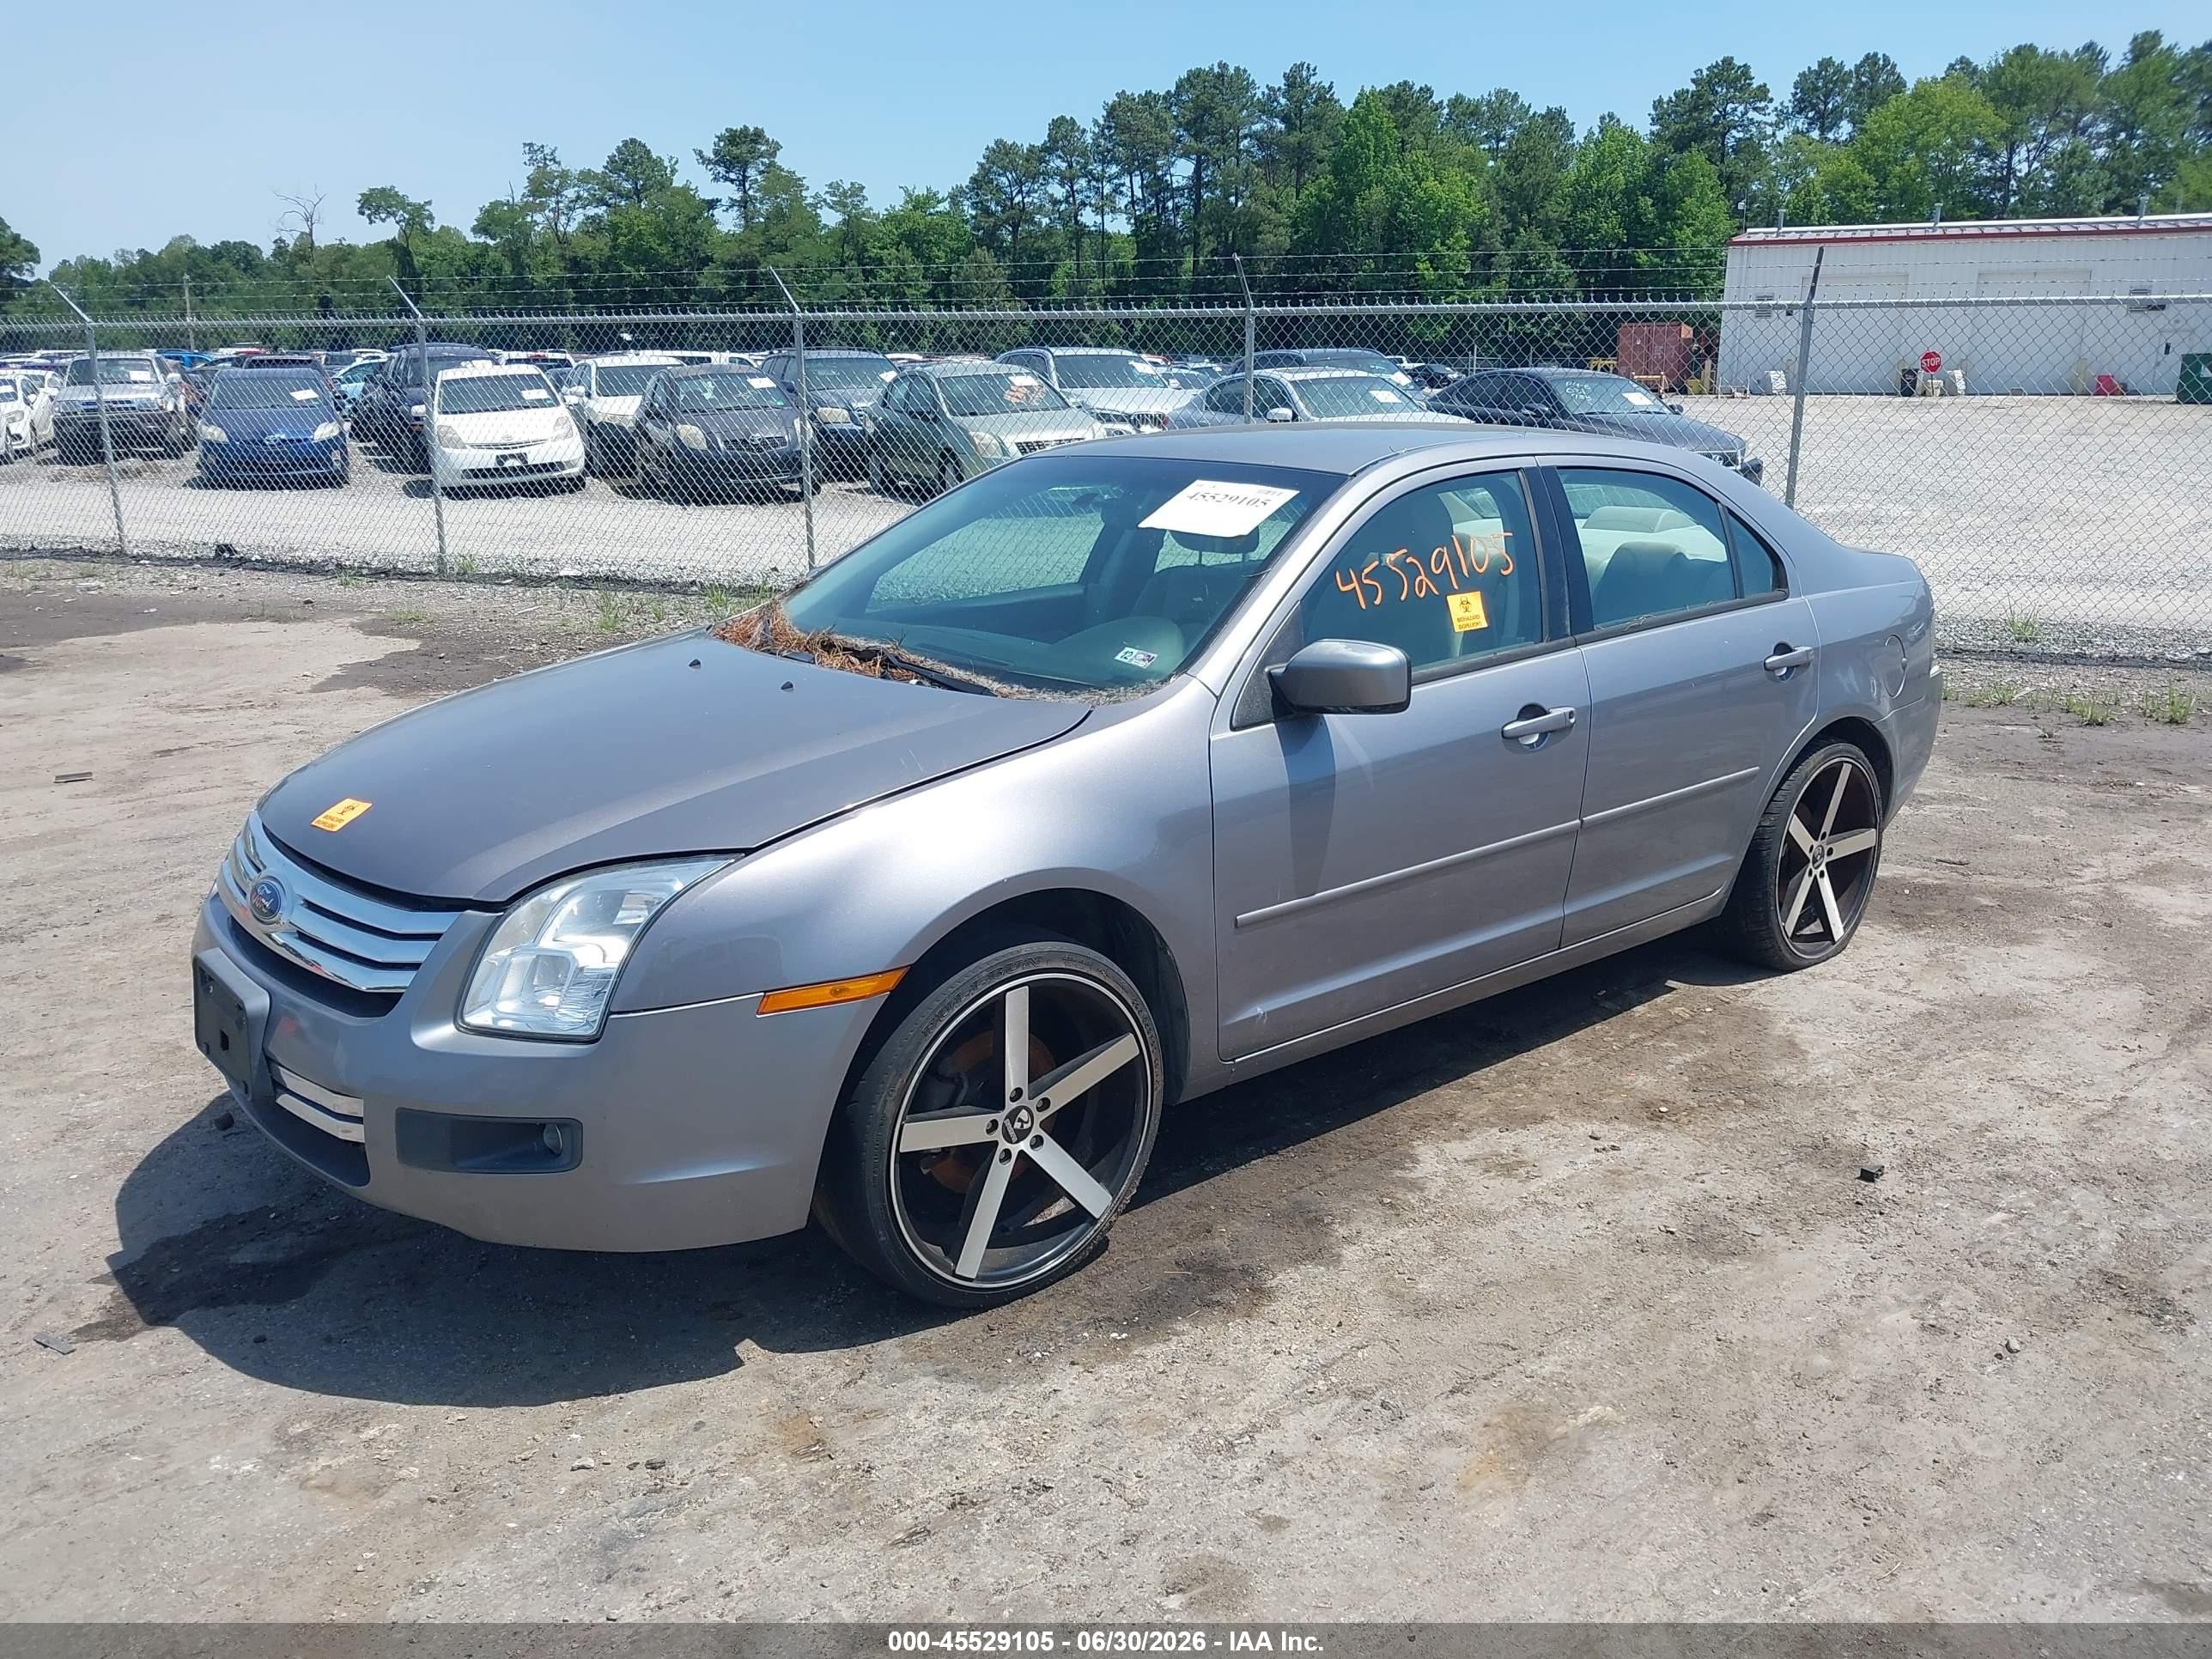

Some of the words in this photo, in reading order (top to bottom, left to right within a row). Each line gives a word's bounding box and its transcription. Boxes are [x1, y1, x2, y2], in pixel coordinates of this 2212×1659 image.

[1921, 356, 1942, 368] STOP
[1187, 491, 1272, 508] 45529105
[1335, 532, 1514, 611] 45529105
[252, 884, 276, 913] Ford
